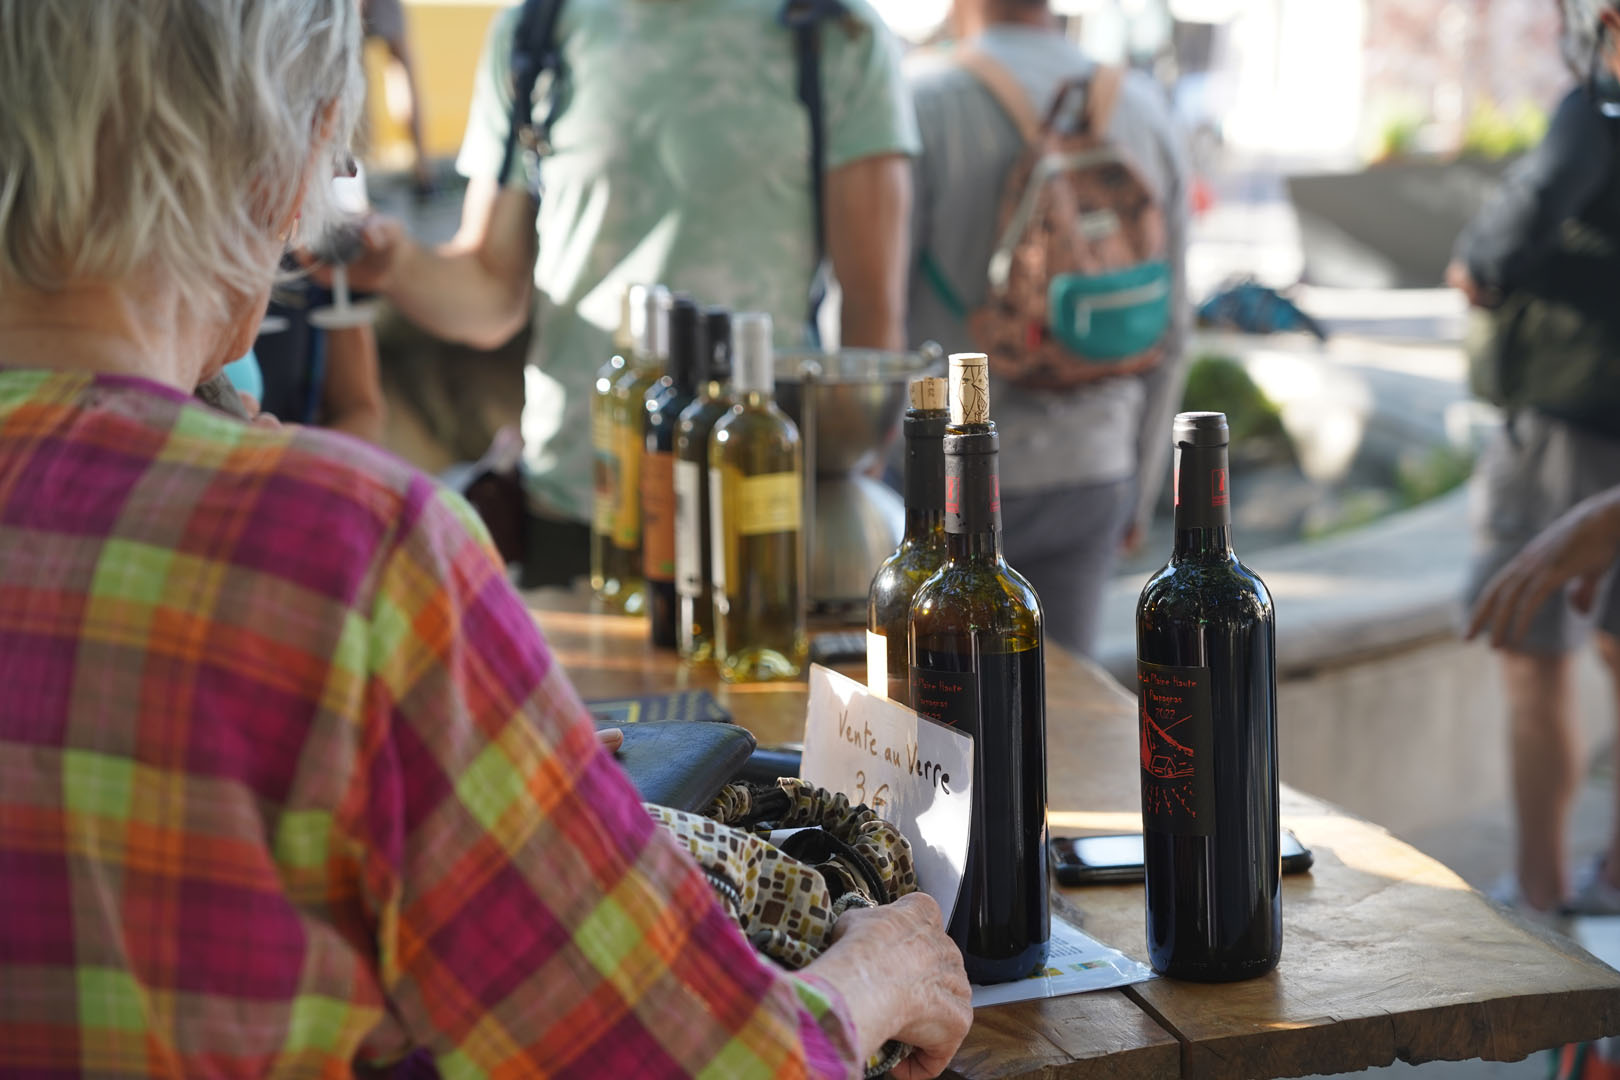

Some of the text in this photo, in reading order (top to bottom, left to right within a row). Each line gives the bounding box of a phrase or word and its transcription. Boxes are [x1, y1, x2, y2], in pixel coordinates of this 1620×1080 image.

[839, 709, 950, 795] Vente au Verre
